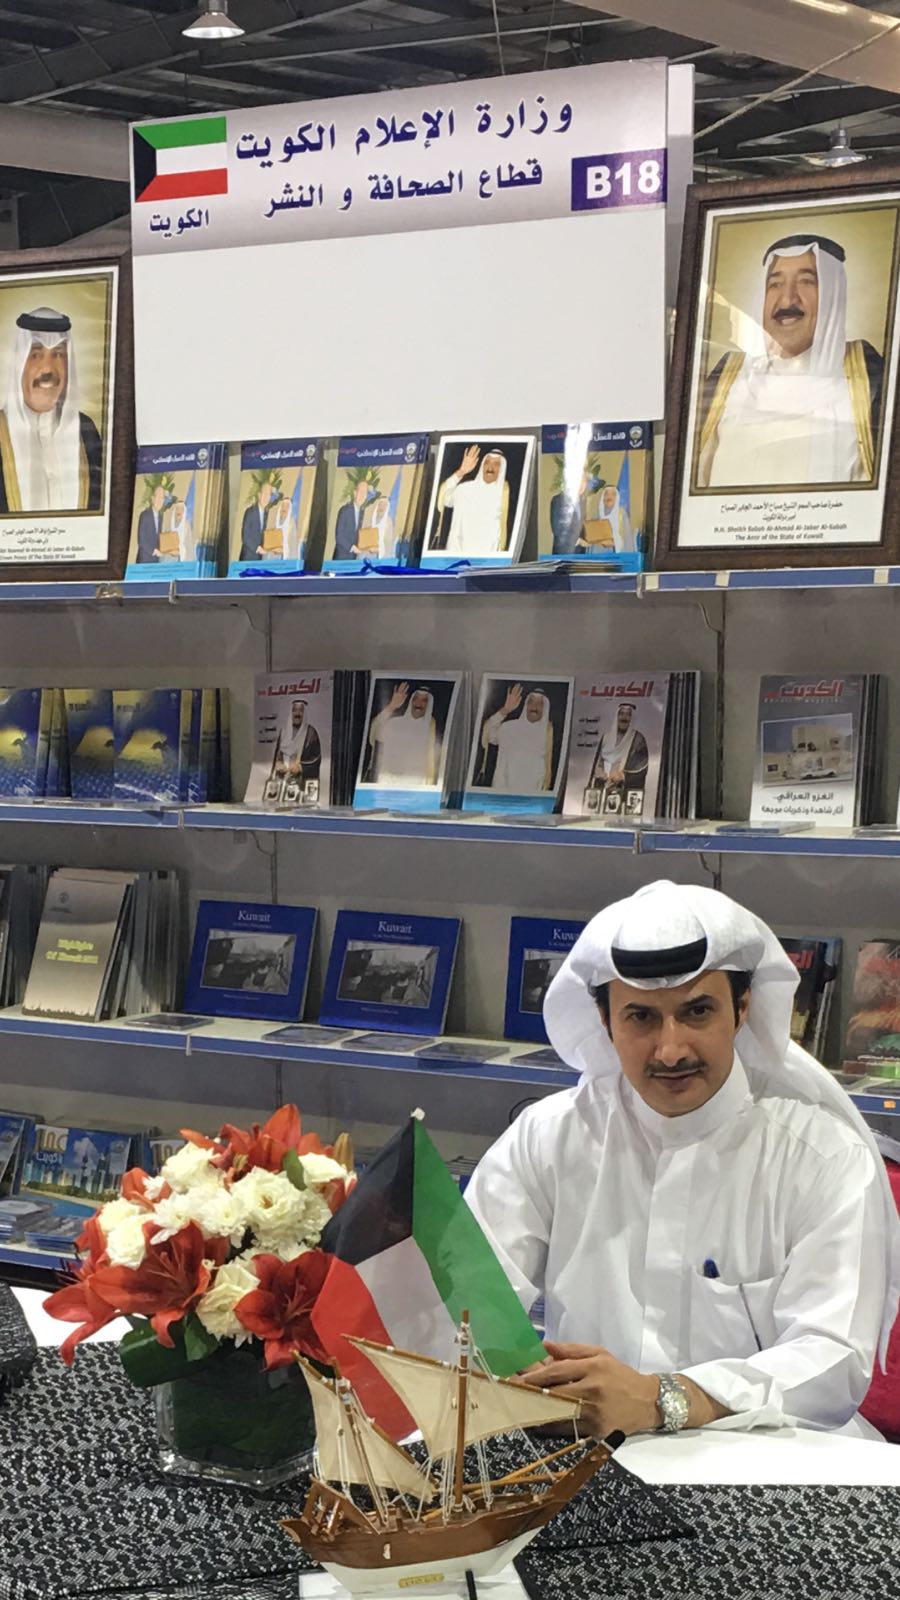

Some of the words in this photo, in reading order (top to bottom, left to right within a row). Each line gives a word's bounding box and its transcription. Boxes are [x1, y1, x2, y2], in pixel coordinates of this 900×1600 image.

[355, 108, 454, 155] الإعلام
[477, 96, 572, 139] وزارة
[236, 123, 335, 168] الكويت
[368, 169, 463, 200] الصحافة
[479, 158, 543, 199] قطاع
[586, 159, 661, 200] B18
[264, 183, 323, 218] النشر
[339, 187, 352, 211] و
[149, 208, 209, 237] الكويت
[268, 678, 321, 699] الكويت
[591, 680, 654, 700] الكويت
[780, 680, 845, 699] الكويت
[812, 792, 834, 802] الغزو
[238, 909, 271, 922] Kuwait
[378, 920, 412, 934] Kuwait
